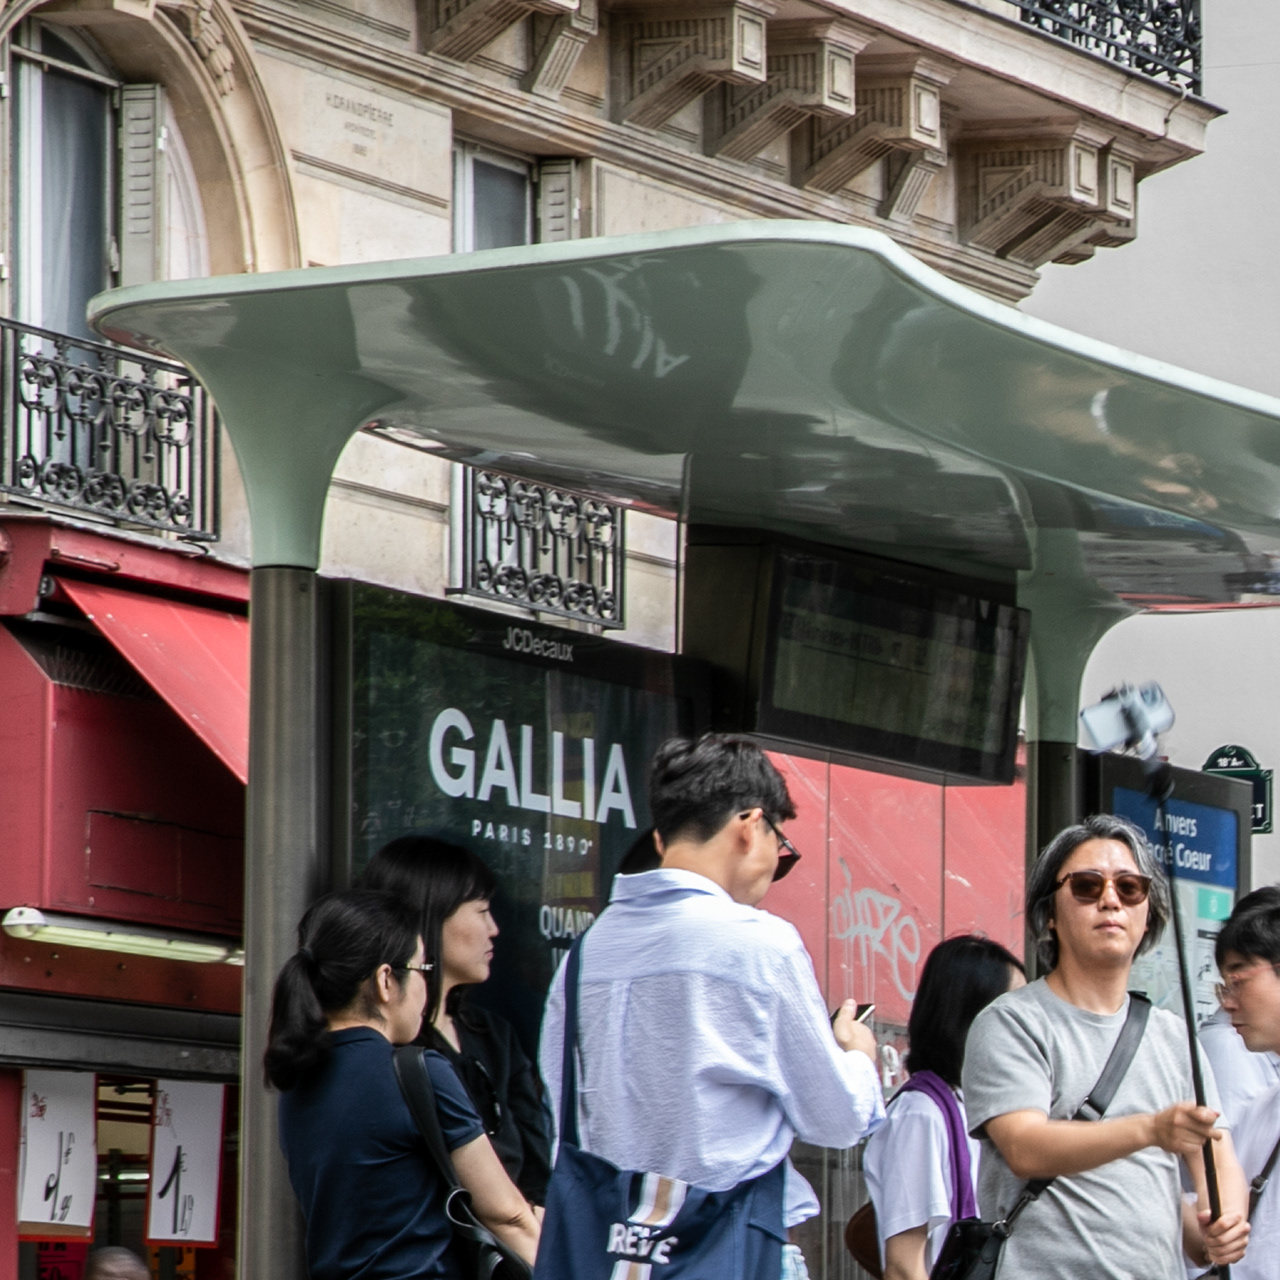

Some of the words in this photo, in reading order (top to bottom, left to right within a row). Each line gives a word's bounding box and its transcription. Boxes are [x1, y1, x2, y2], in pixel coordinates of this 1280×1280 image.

[503, 626, 574, 662] JCDecaux
[429, 707, 638, 829] GALLIA
[472, 819, 532, 846] PARIS
[1154, 808, 1197, 837] Anvers
[1176, 842, 1212, 871] Coeur
